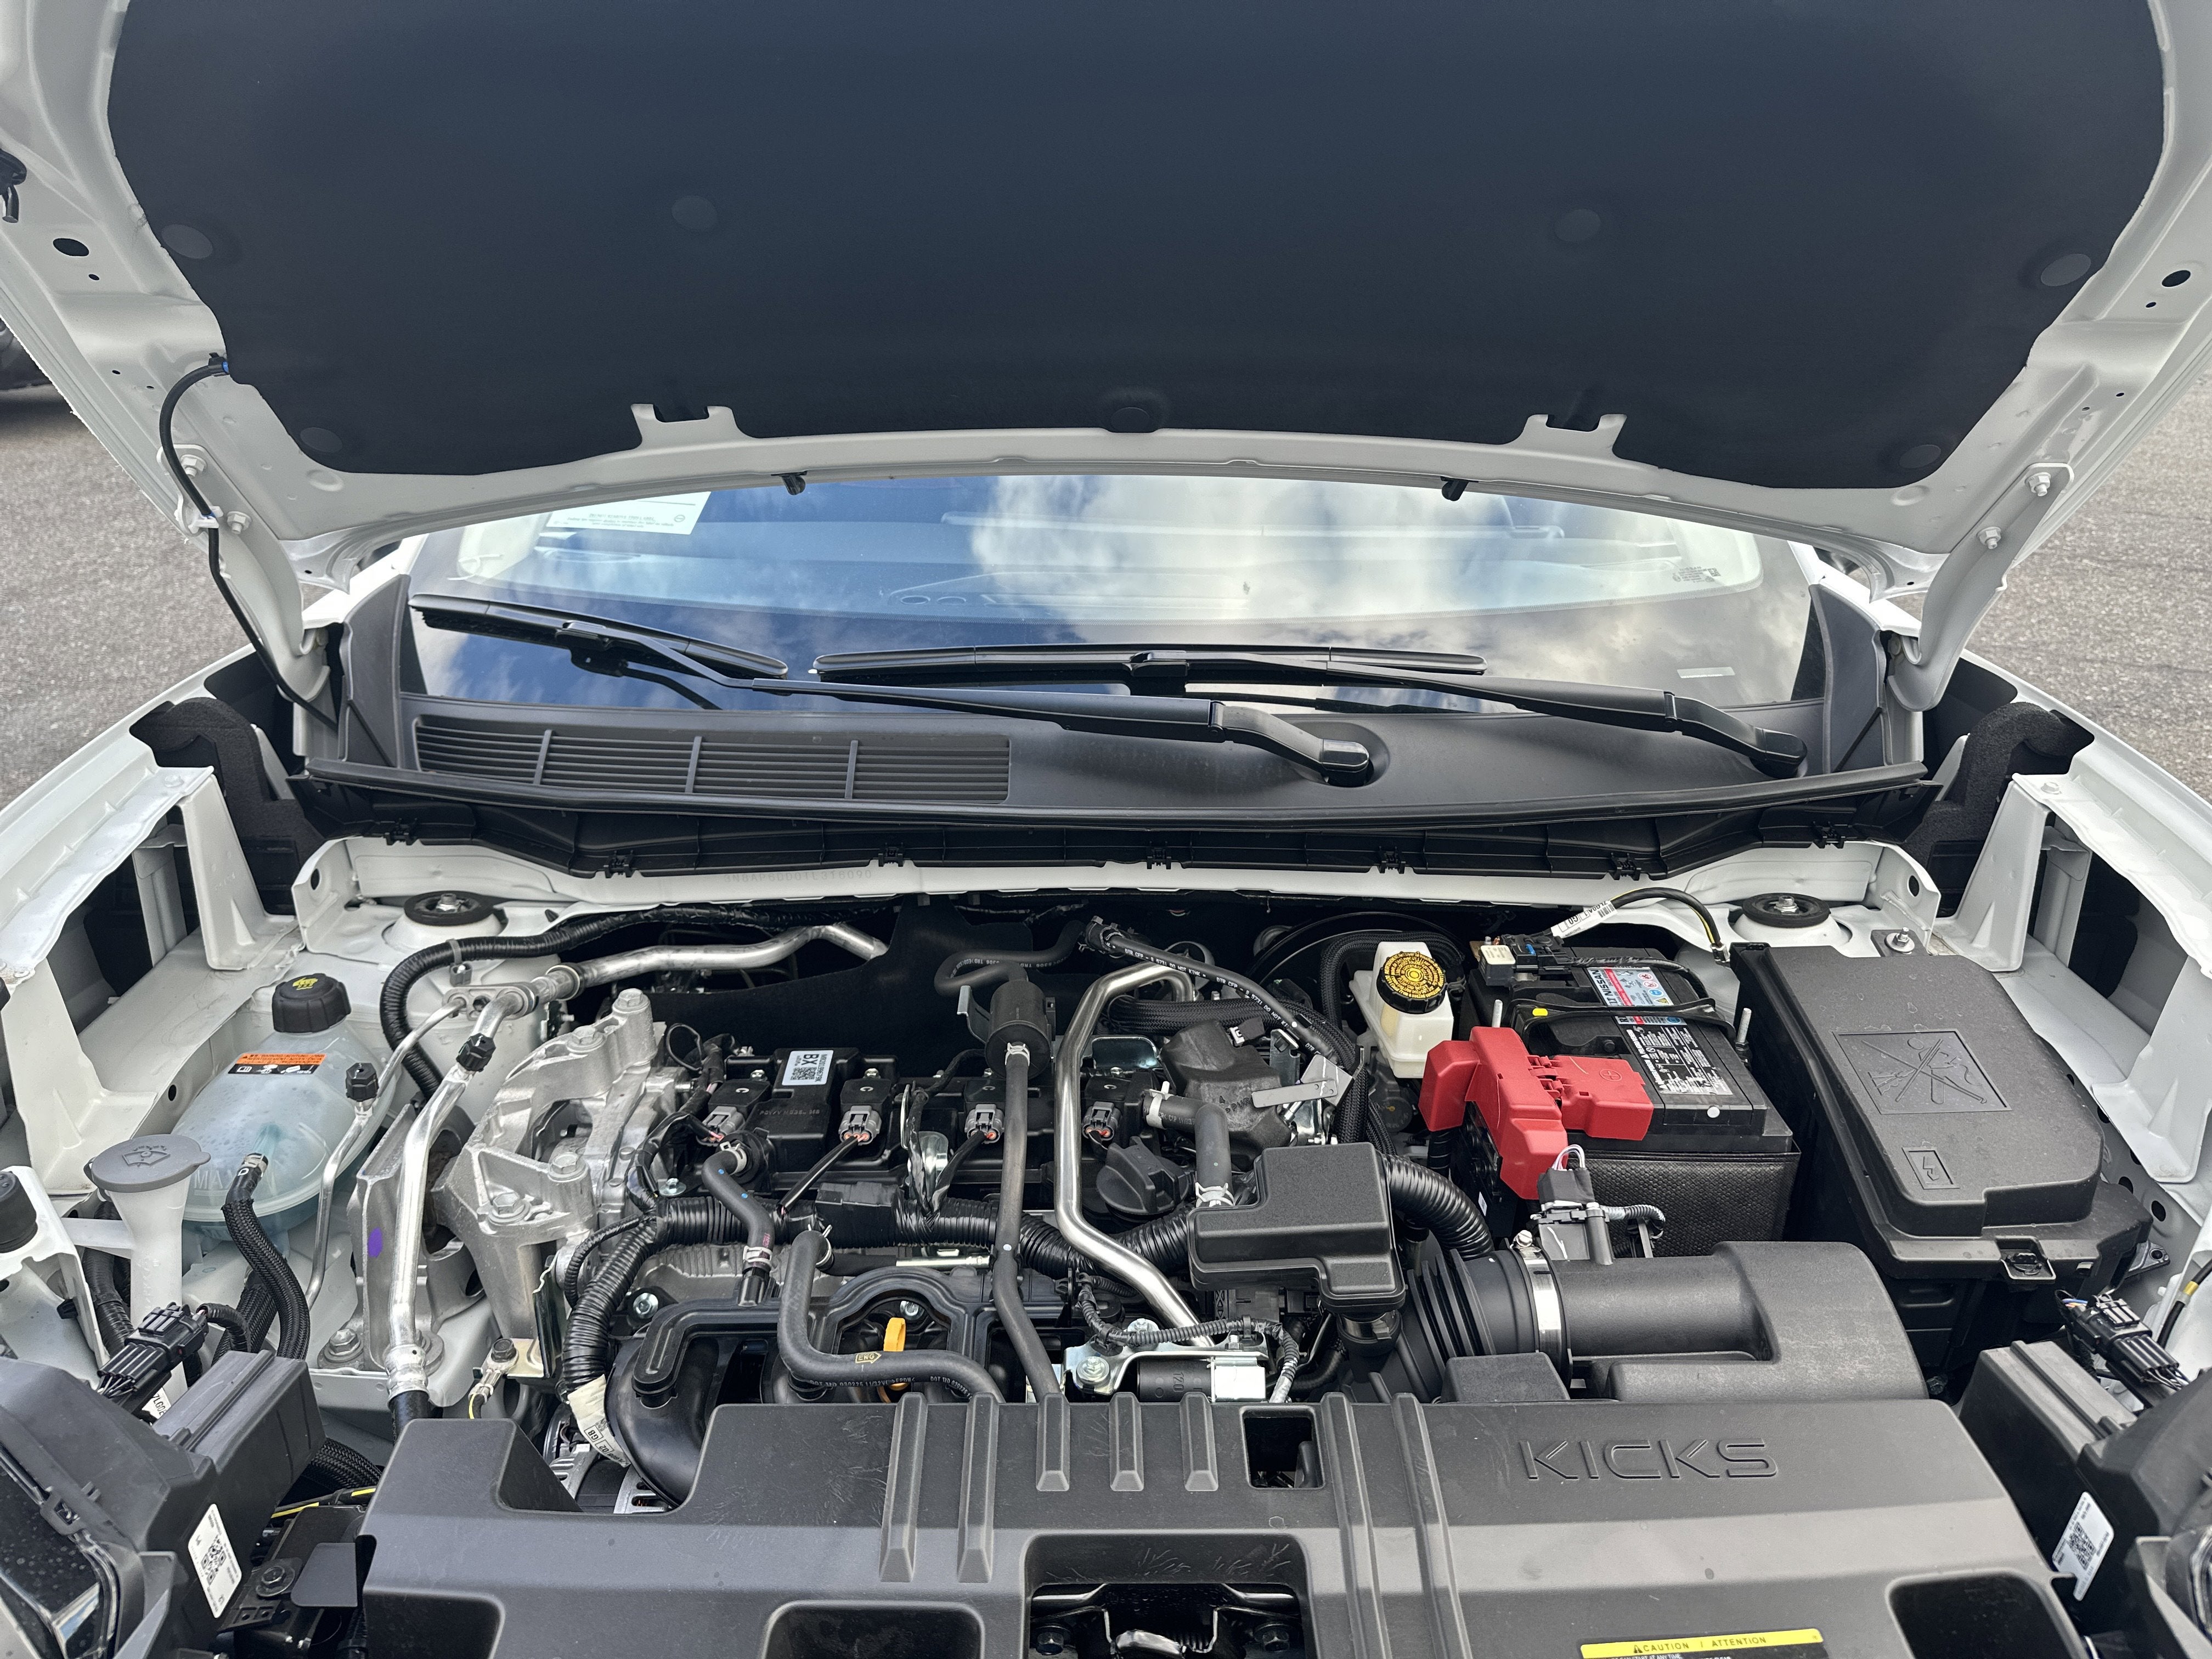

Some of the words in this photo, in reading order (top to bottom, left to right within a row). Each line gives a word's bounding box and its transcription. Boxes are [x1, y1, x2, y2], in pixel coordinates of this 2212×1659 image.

[1591, 969, 1613, 1000] NISSAN
[1263, 1005, 1271, 1013] DO
[1271, 1012, 1282, 1022] NOT
[801, 1054, 820, 1065] BX
[588, 1430, 599, 1440] GB
[1519, 1438, 1779, 1481] KICKS
[1643, 1642, 1690, 1652] CAUTION
[1712, 1637, 1767, 1647] ATTENTION
